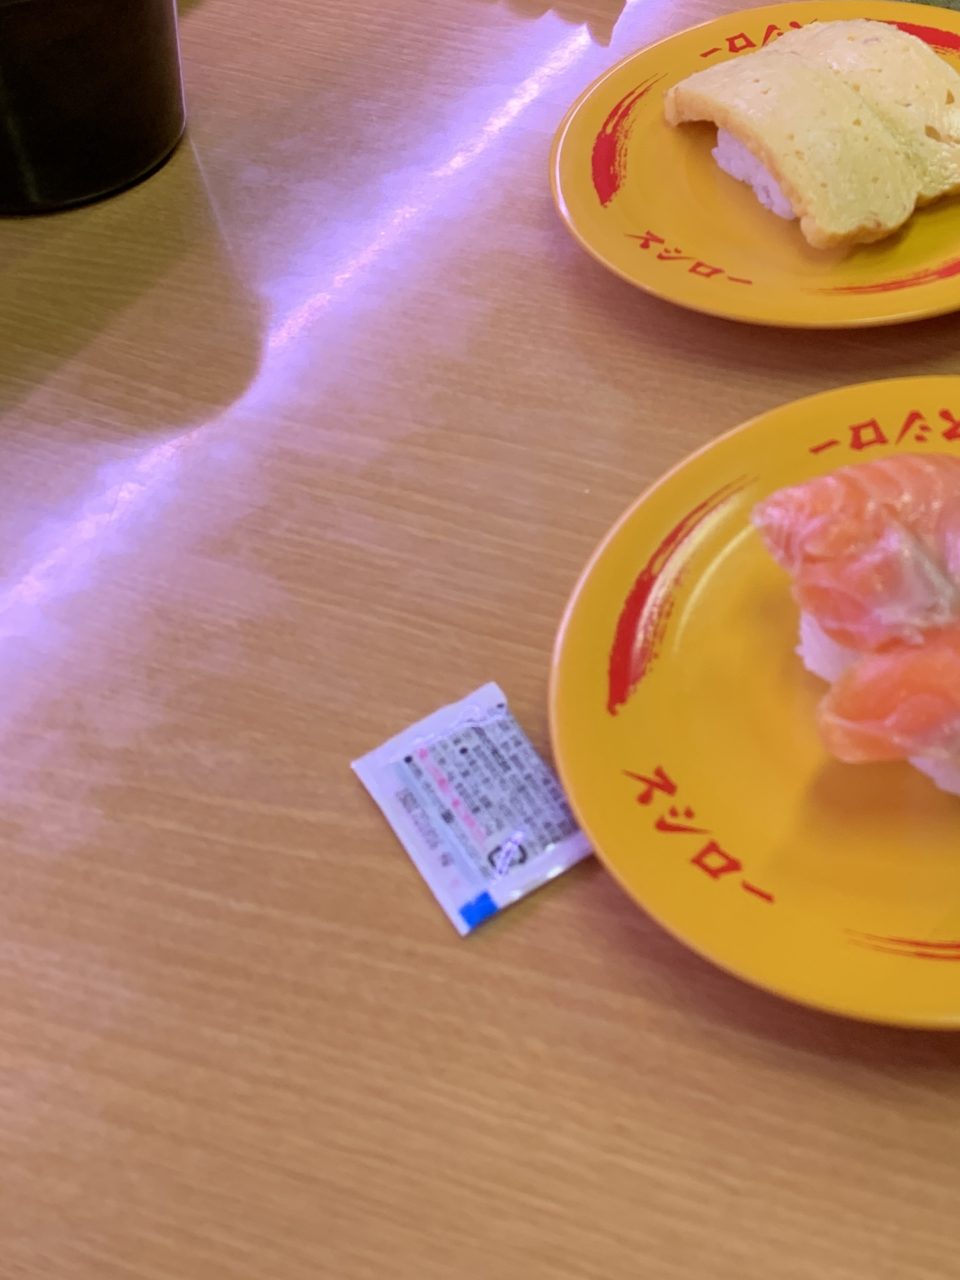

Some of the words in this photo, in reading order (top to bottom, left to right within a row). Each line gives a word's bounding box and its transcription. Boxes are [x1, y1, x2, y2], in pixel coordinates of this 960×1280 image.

[624, 229, 754, 286] スシロー
[622, 767, 776, 906] スシロー
